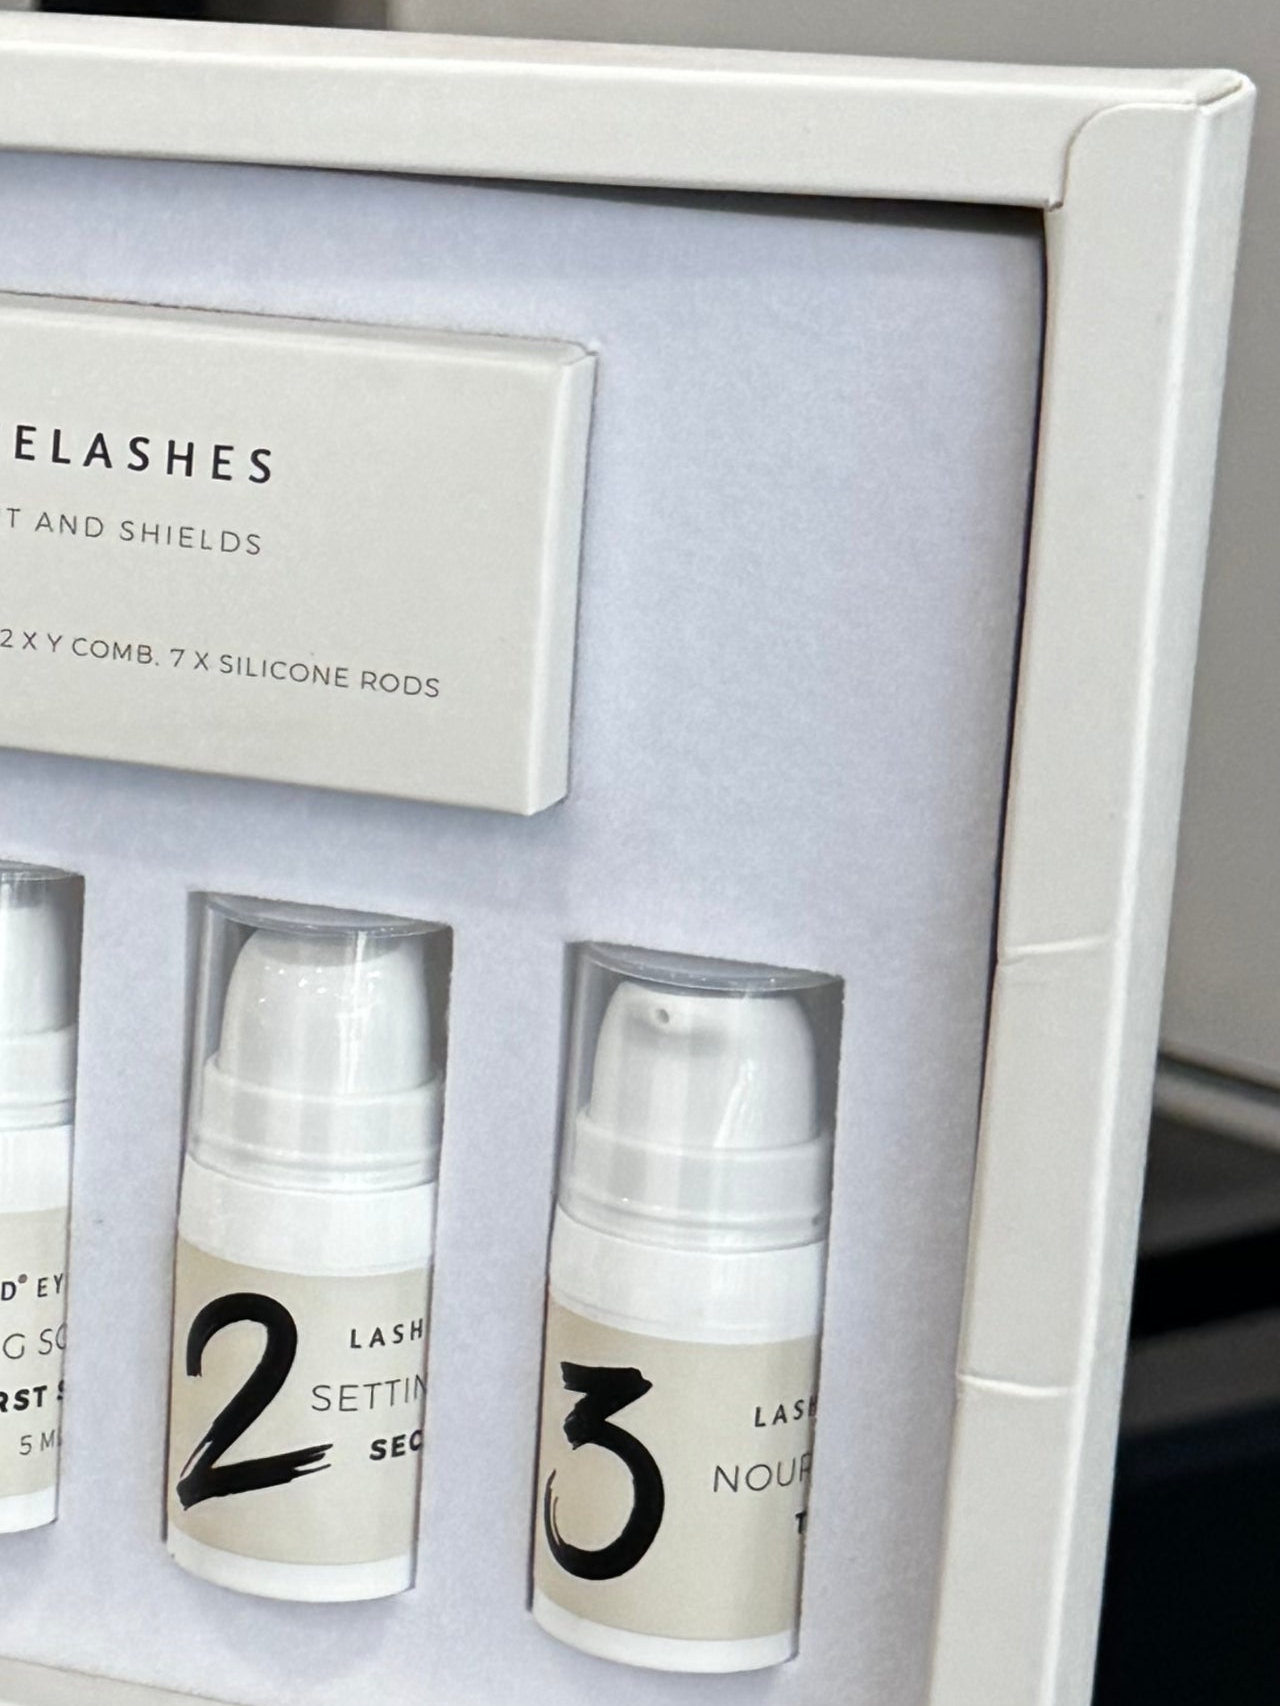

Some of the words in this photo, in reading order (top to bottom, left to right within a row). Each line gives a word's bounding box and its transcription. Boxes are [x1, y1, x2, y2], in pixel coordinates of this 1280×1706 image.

[34, 511, 106, 540] AND
[119, 520, 263, 557] SHIELDS
[0, 628, 14, 649] 2
[21, 631, 38, 651] X
[47, 633, 62, 653] Y
[170, 648, 185, 668] 7
[193, 651, 210, 671] X
[219, 654, 349, 689] SILICONE
[360, 670, 440, 699] RODS
[350, 1317, 424, 1349] LASH
[176, 1292, 334, 1511] 2
[19, 1434, 32, 1456] 5
[544, 1361, 665, 1581] 3
